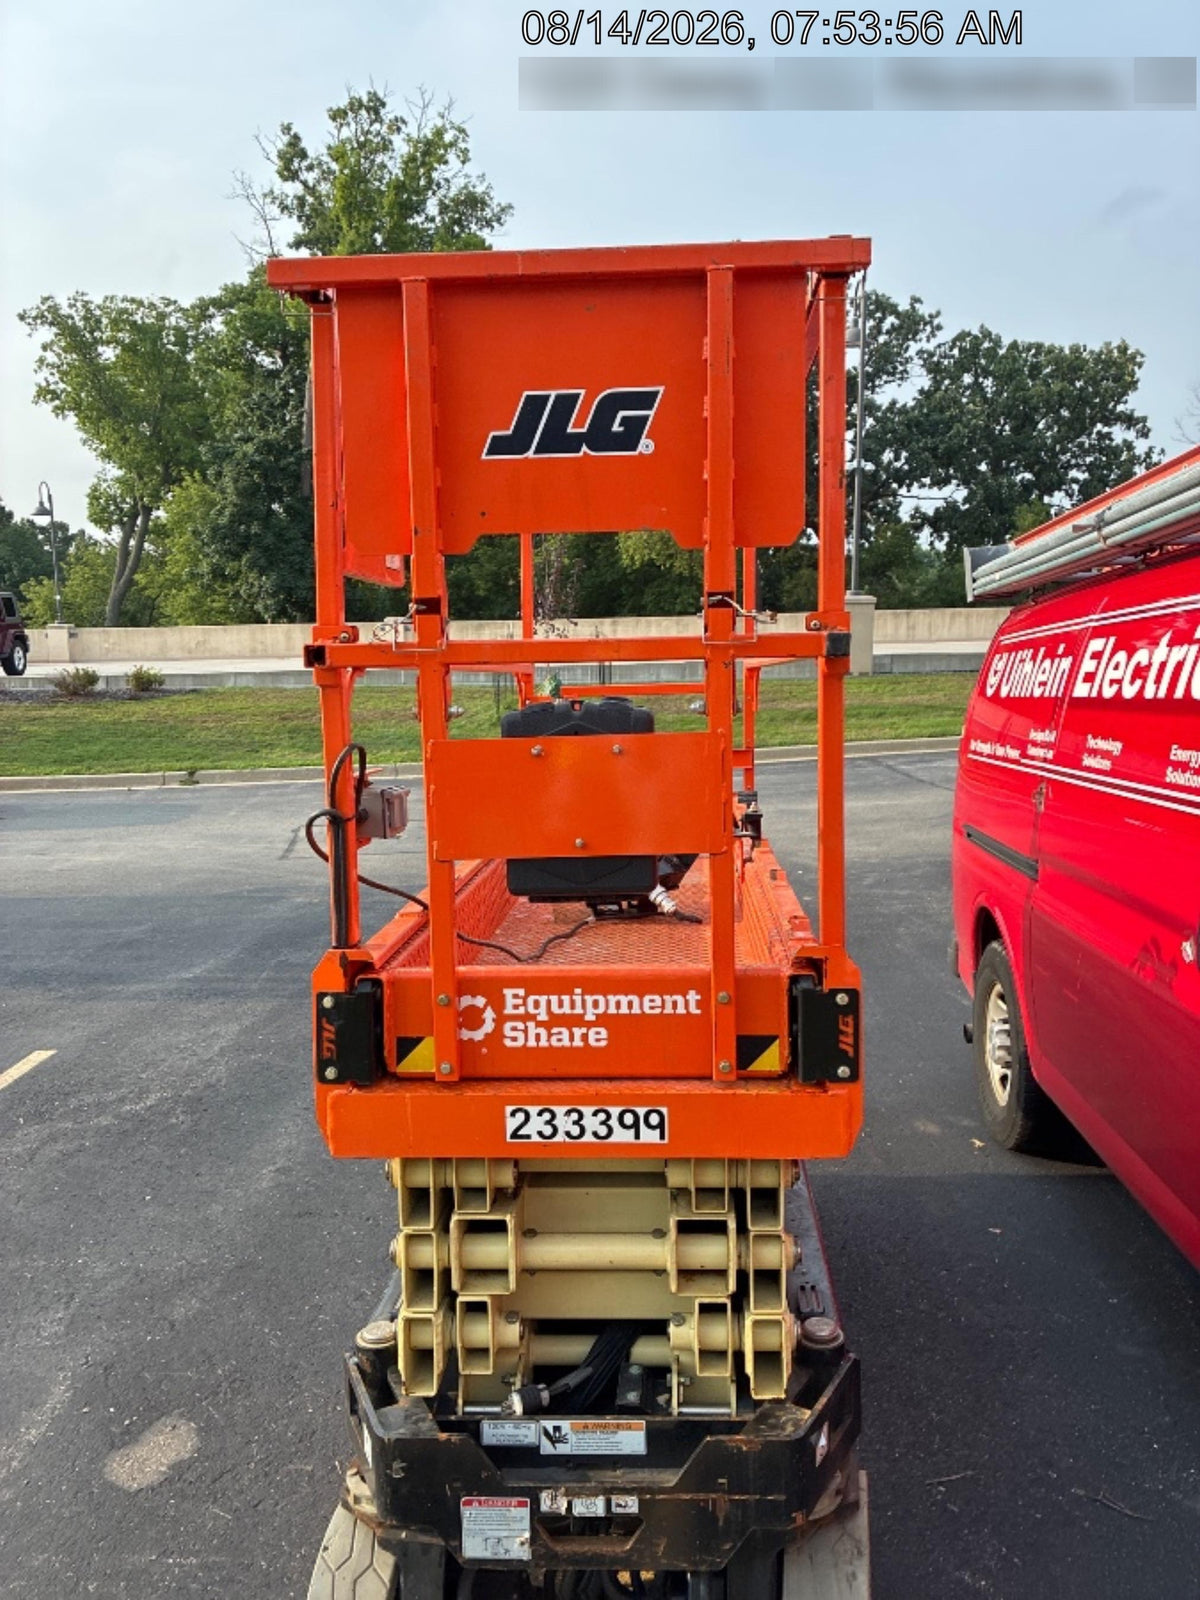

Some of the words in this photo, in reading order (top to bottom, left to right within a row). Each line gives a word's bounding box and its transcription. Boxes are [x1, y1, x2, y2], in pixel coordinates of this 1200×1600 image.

[481, 386, 665, 460] JLG
[999, 642, 1073, 698] Uihlein
[1086, 733, 1124, 756] Technology
[502, 987, 702, 1021] Equipment
[321, 1016, 337, 1061] JLG
[502, 1021, 609, 1048] Share
[838, 1014, 854, 1059] JLG
[507, 1106, 668, 1142] 233399
